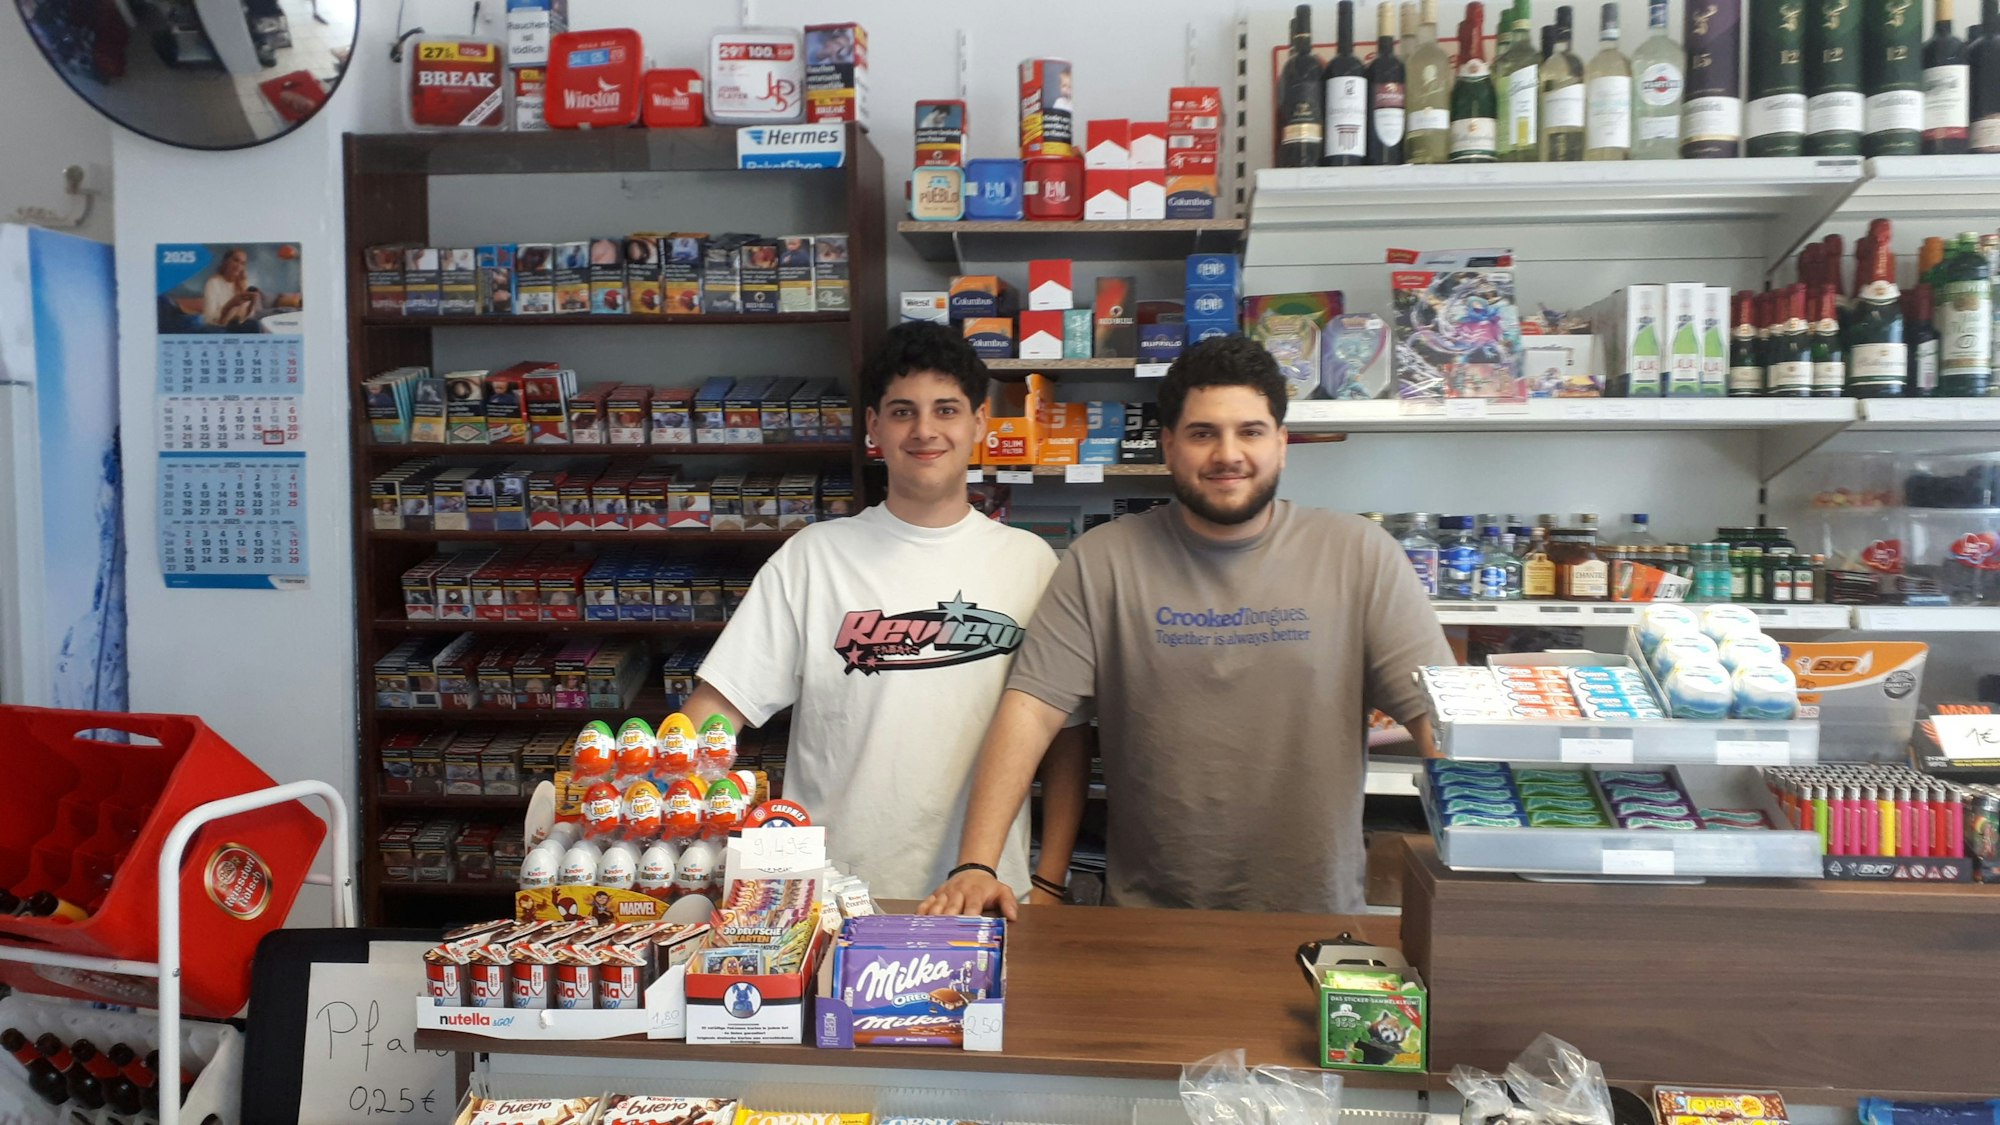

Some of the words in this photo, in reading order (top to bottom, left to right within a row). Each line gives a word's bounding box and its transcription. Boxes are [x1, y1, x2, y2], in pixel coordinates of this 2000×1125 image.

[419, 71, 495, 88] BREAK
[564, 88, 620, 110] Winston
[767, 130, 839, 145] Hermes
[920, 187, 960, 204] PUEBLO
[1168, 197, 1212, 207] Columbus
[163, 251, 196, 264] 2025
[952, 296, 993, 306] Columbus
[968, 338, 1009, 347] Columbus
[986, 431, 999, 448] 6
[1001, 440, 1024, 448] SLIM
[1156, 630, 1211, 647] Together
[1214, 632, 1225, 645] is
[1227, 631, 1269, 647] always
[1271, 628, 1310, 642] better
[1812, 660, 1857, 671] BIC
[528, 869, 547, 877] Kinder
[644, 865, 664, 873] Kinder
[684, 866, 703, 874] Kinder
[1861, 864, 1891, 874] BIC
[619, 902, 656, 916] MARVEL
[724, 927, 737, 936] 30
[737, 927, 783, 936] DEUTSCHE
[733, 935, 771, 944] KARTEN
[856, 954, 953, 1002] Milka
[894, 994, 929, 1006] OREO
[439, 1013, 490, 1026] nutella
[652, 1009, 680, 1025] 1,80
[853, 1015, 951, 1029] Milka
[965, 1015, 1001, 1041] 2,50
[498, 1101, 550, 1115] bueno
[627, 1101, 688, 1115] bueno
